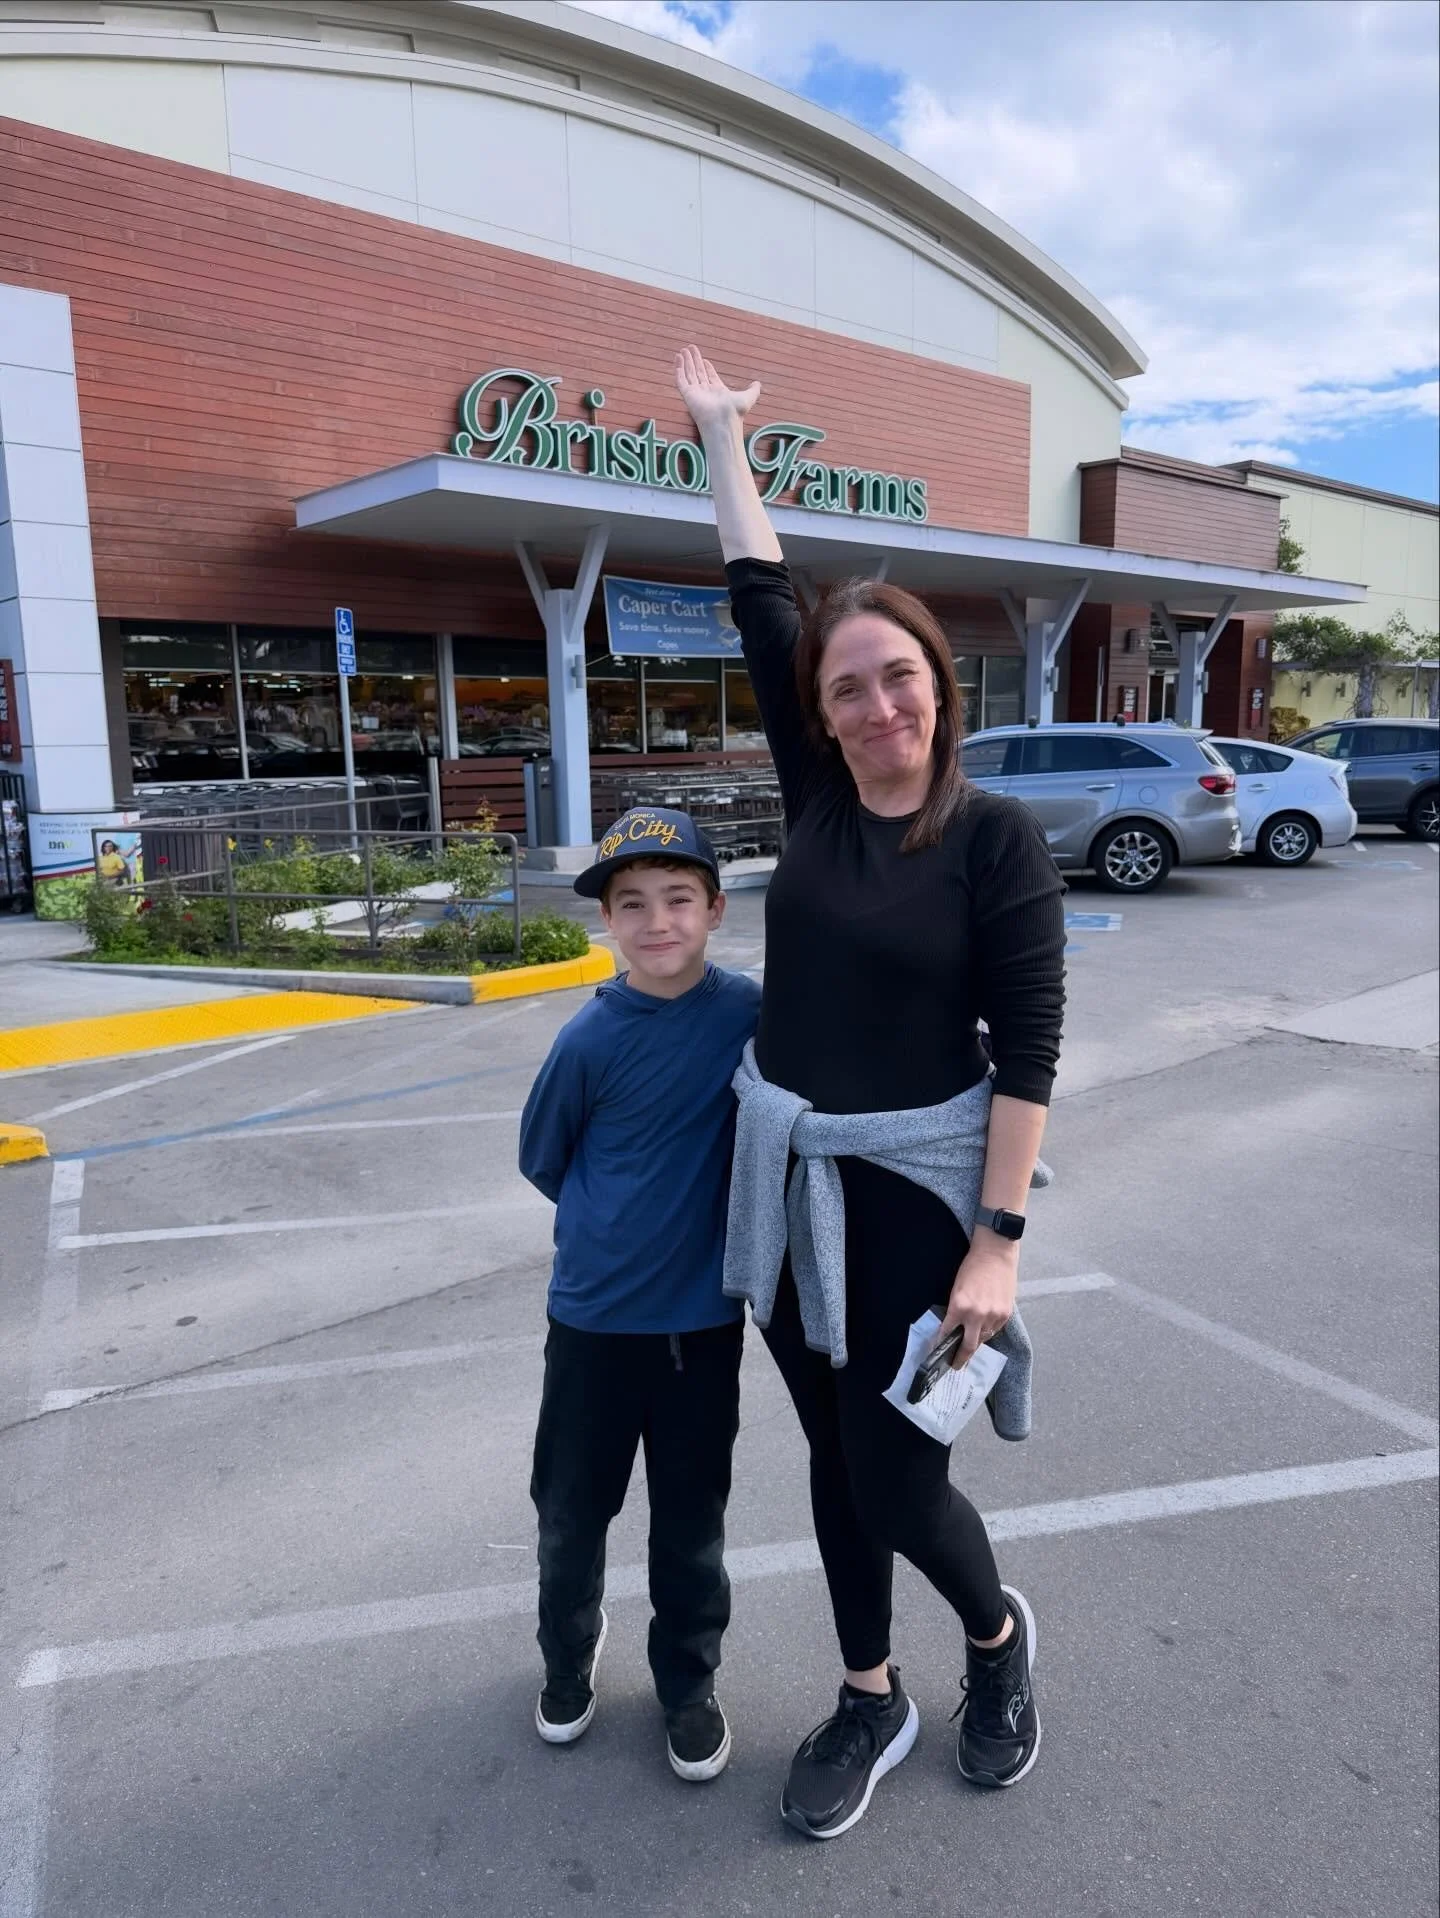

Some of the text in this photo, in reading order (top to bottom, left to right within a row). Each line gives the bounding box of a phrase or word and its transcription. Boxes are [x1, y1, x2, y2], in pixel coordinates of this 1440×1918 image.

[451, 368, 929, 523] Bristo Farms
[618, 594, 708, 619] Caper Cart
[619, 621, 639, 631] Save
[663, 624, 682, 633] Save
[599, 819, 683, 861] Rip City
